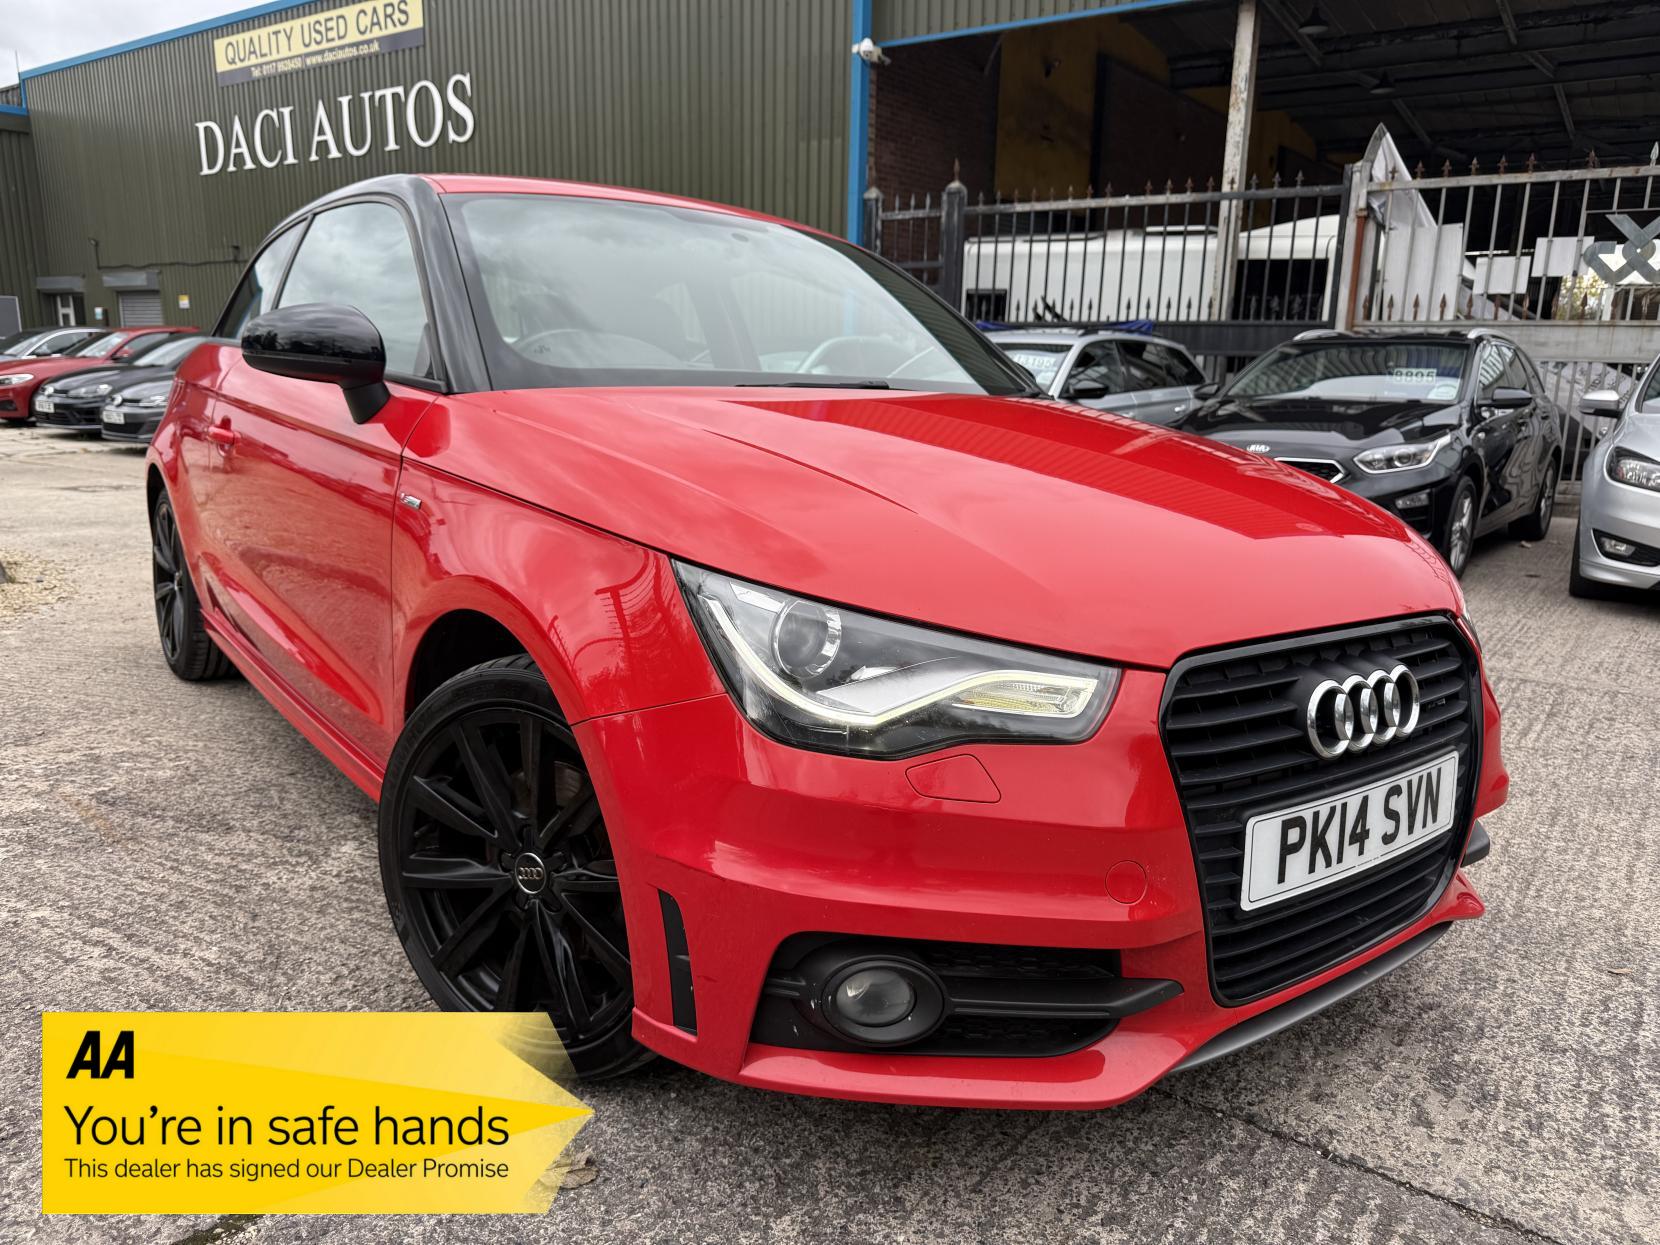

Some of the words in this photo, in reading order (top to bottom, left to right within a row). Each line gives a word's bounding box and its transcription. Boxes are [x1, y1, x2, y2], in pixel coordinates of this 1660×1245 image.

[225, 26, 294, 65] QUALITY
[300, 14, 348, 48] USED
[356, 0, 410, 36] CARS
[195, 106, 299, 175] DACI
[309, 72, 475, 161] AUTOS
[1277, 795, 1370, 885] PK14
[1381, 766, 1442, 846] SVN
